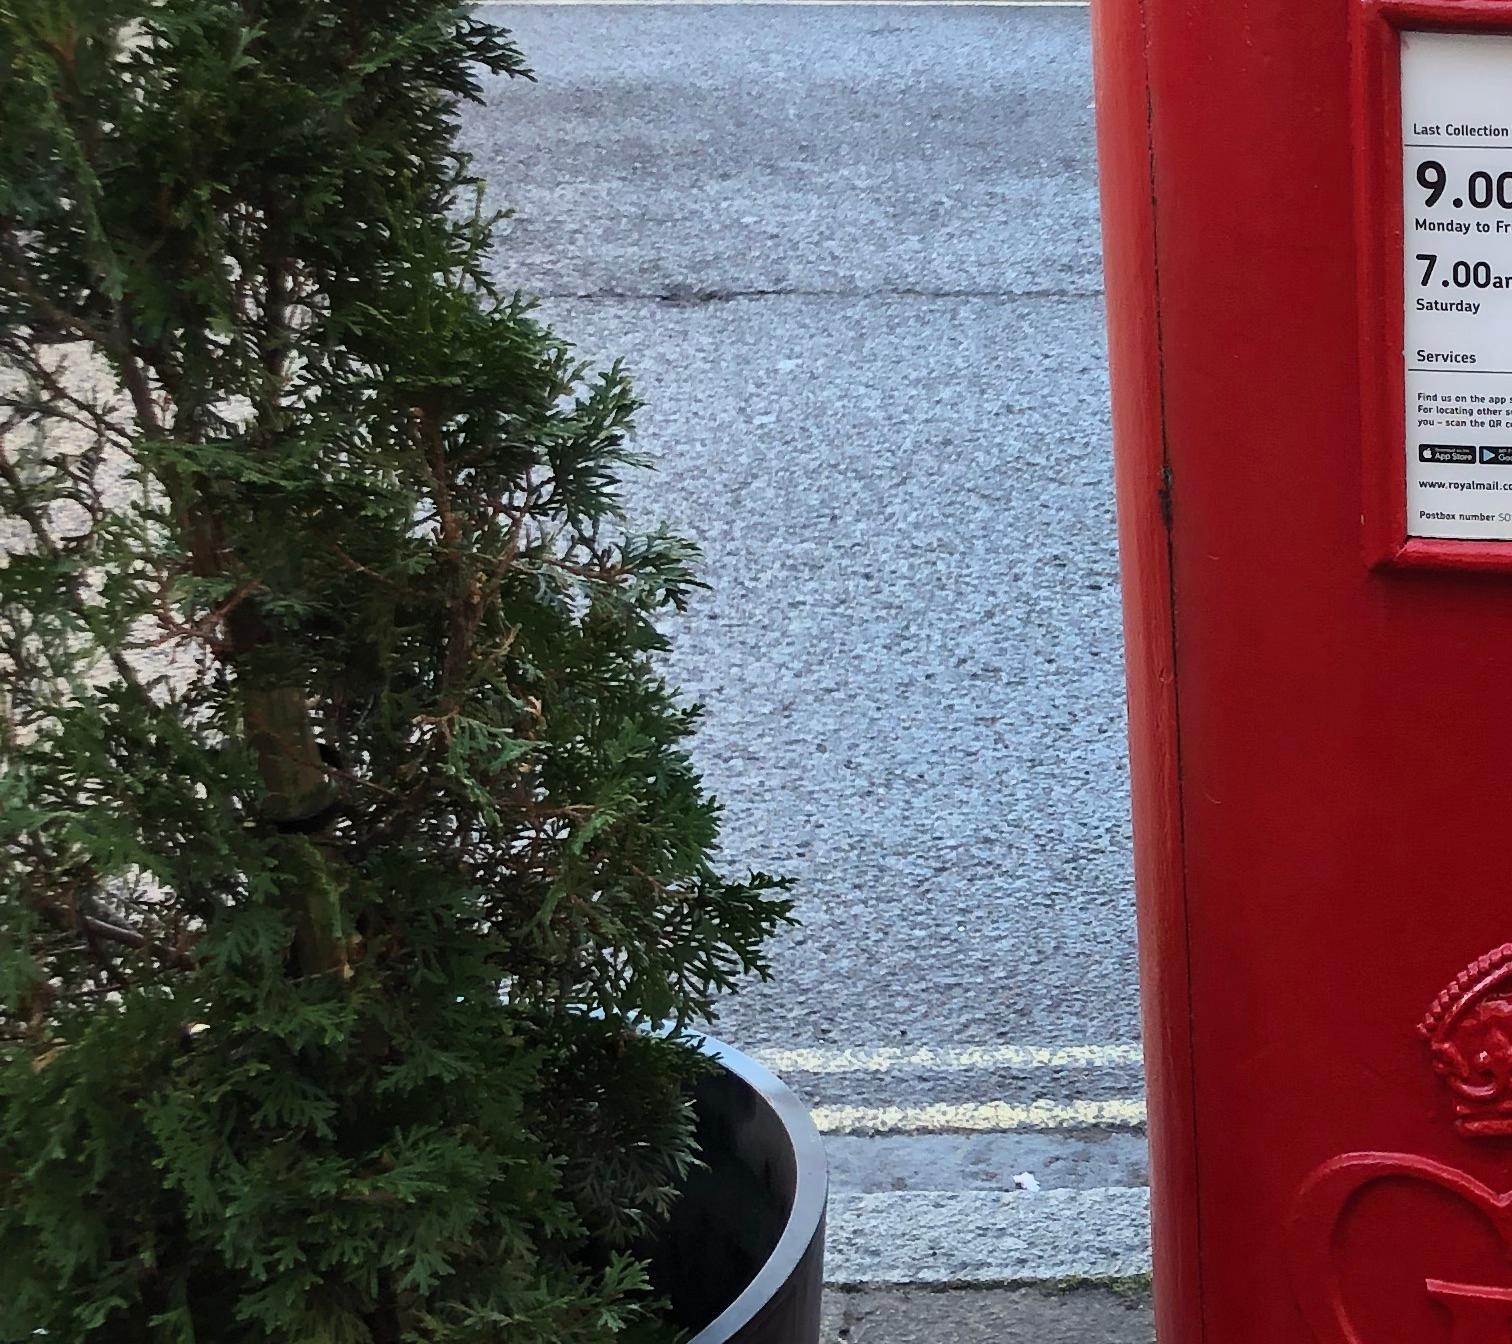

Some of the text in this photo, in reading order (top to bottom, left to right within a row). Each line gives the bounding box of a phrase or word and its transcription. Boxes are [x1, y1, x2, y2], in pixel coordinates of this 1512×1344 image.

[1414, 123, 1441, 136] Last
[1446, 124, 1508, 137] Collection
[1415, 218, 1470, 235] Monday
[1476, 222, 1490, 233] to
[1416, 299, 1480, 314] Saturday
[1417, 350, 1476, 363] Services
[1418, 393, 1437, 402] Find
[1470, 395, 1485, 403] the
[1489, 396, 1506, 405] app
[1418, 405, 1432, 414] For
[1436, 406, 1473, 416] locating
[1477, 408, 1502, 416] other
[1452, 453, 1472, 461] Store
[1420, 511, 1455, 520] Postbox
[1460, 512, 1495, 521] number
